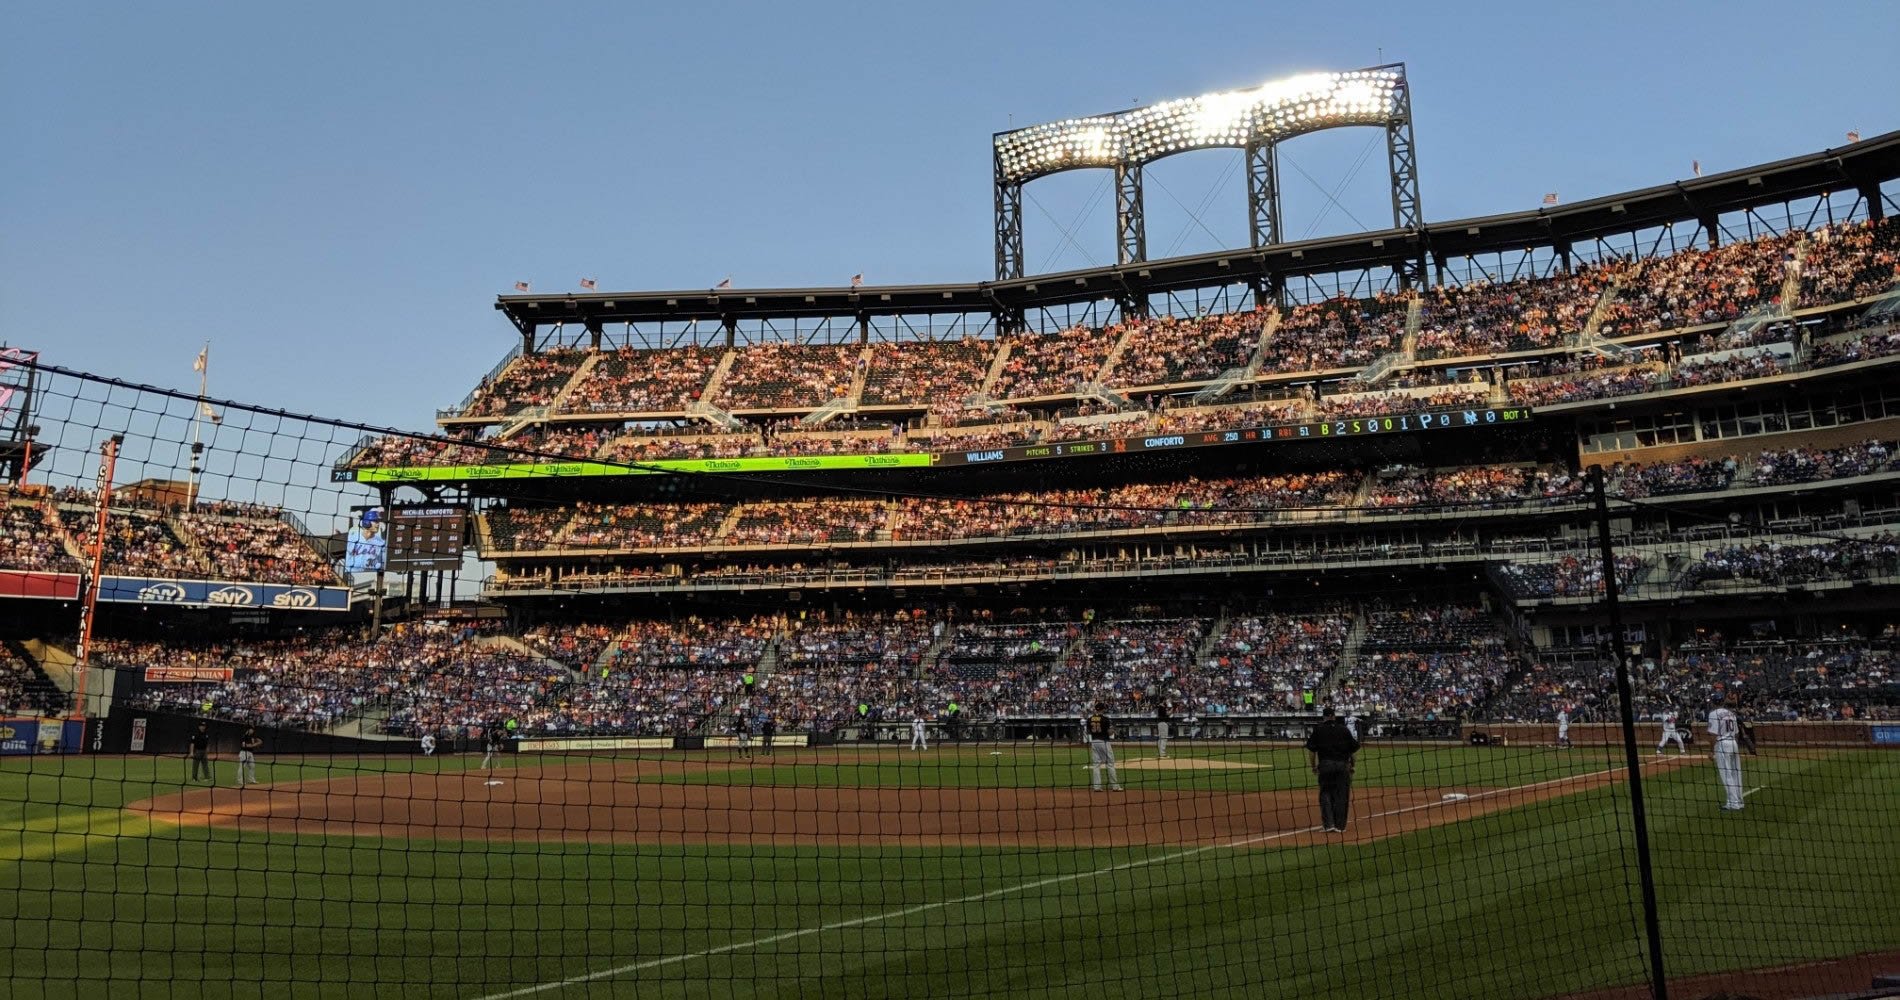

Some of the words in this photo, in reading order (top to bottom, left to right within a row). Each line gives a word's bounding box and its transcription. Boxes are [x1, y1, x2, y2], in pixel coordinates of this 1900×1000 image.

[1321, 423, 1330, 435] B
[1335, 422, 1346, 435] 2
[1353, 421, 1361, 433] S
[1367, 419, 1379, 432] 0
[1400, 417, 1409, 430] 1
[1419, 414, 1433, 429] P
[1440, 415, 1450, 426] 0
[1486, 411, 1496, 423] 0
[1503, 411, 1519, 421] BOT
[1523, 410, 1529, 419] 1
[1145, 436, 1185, 448] CONFORTO
[1203, 434, 1219, 443] AVG
[1223, 432, 1239, 442] .250
[1245, 431, 1256, 440] HR
[1262, 429, 1272, 439] 18
[1278, 428, 1292, 437] RBI
[1299, 426, 1309, 436] 51
[966, 450, 1004, 463] WILLIAMS
[1026, 448, 1050, 457] PITCHES
[1056, 446, 1062, 455] 5
[1070, 444, 1094, 453] STRIKES
[1101, 442, 1107, 451] 3
[1725, 719, 1735, 732] 10
